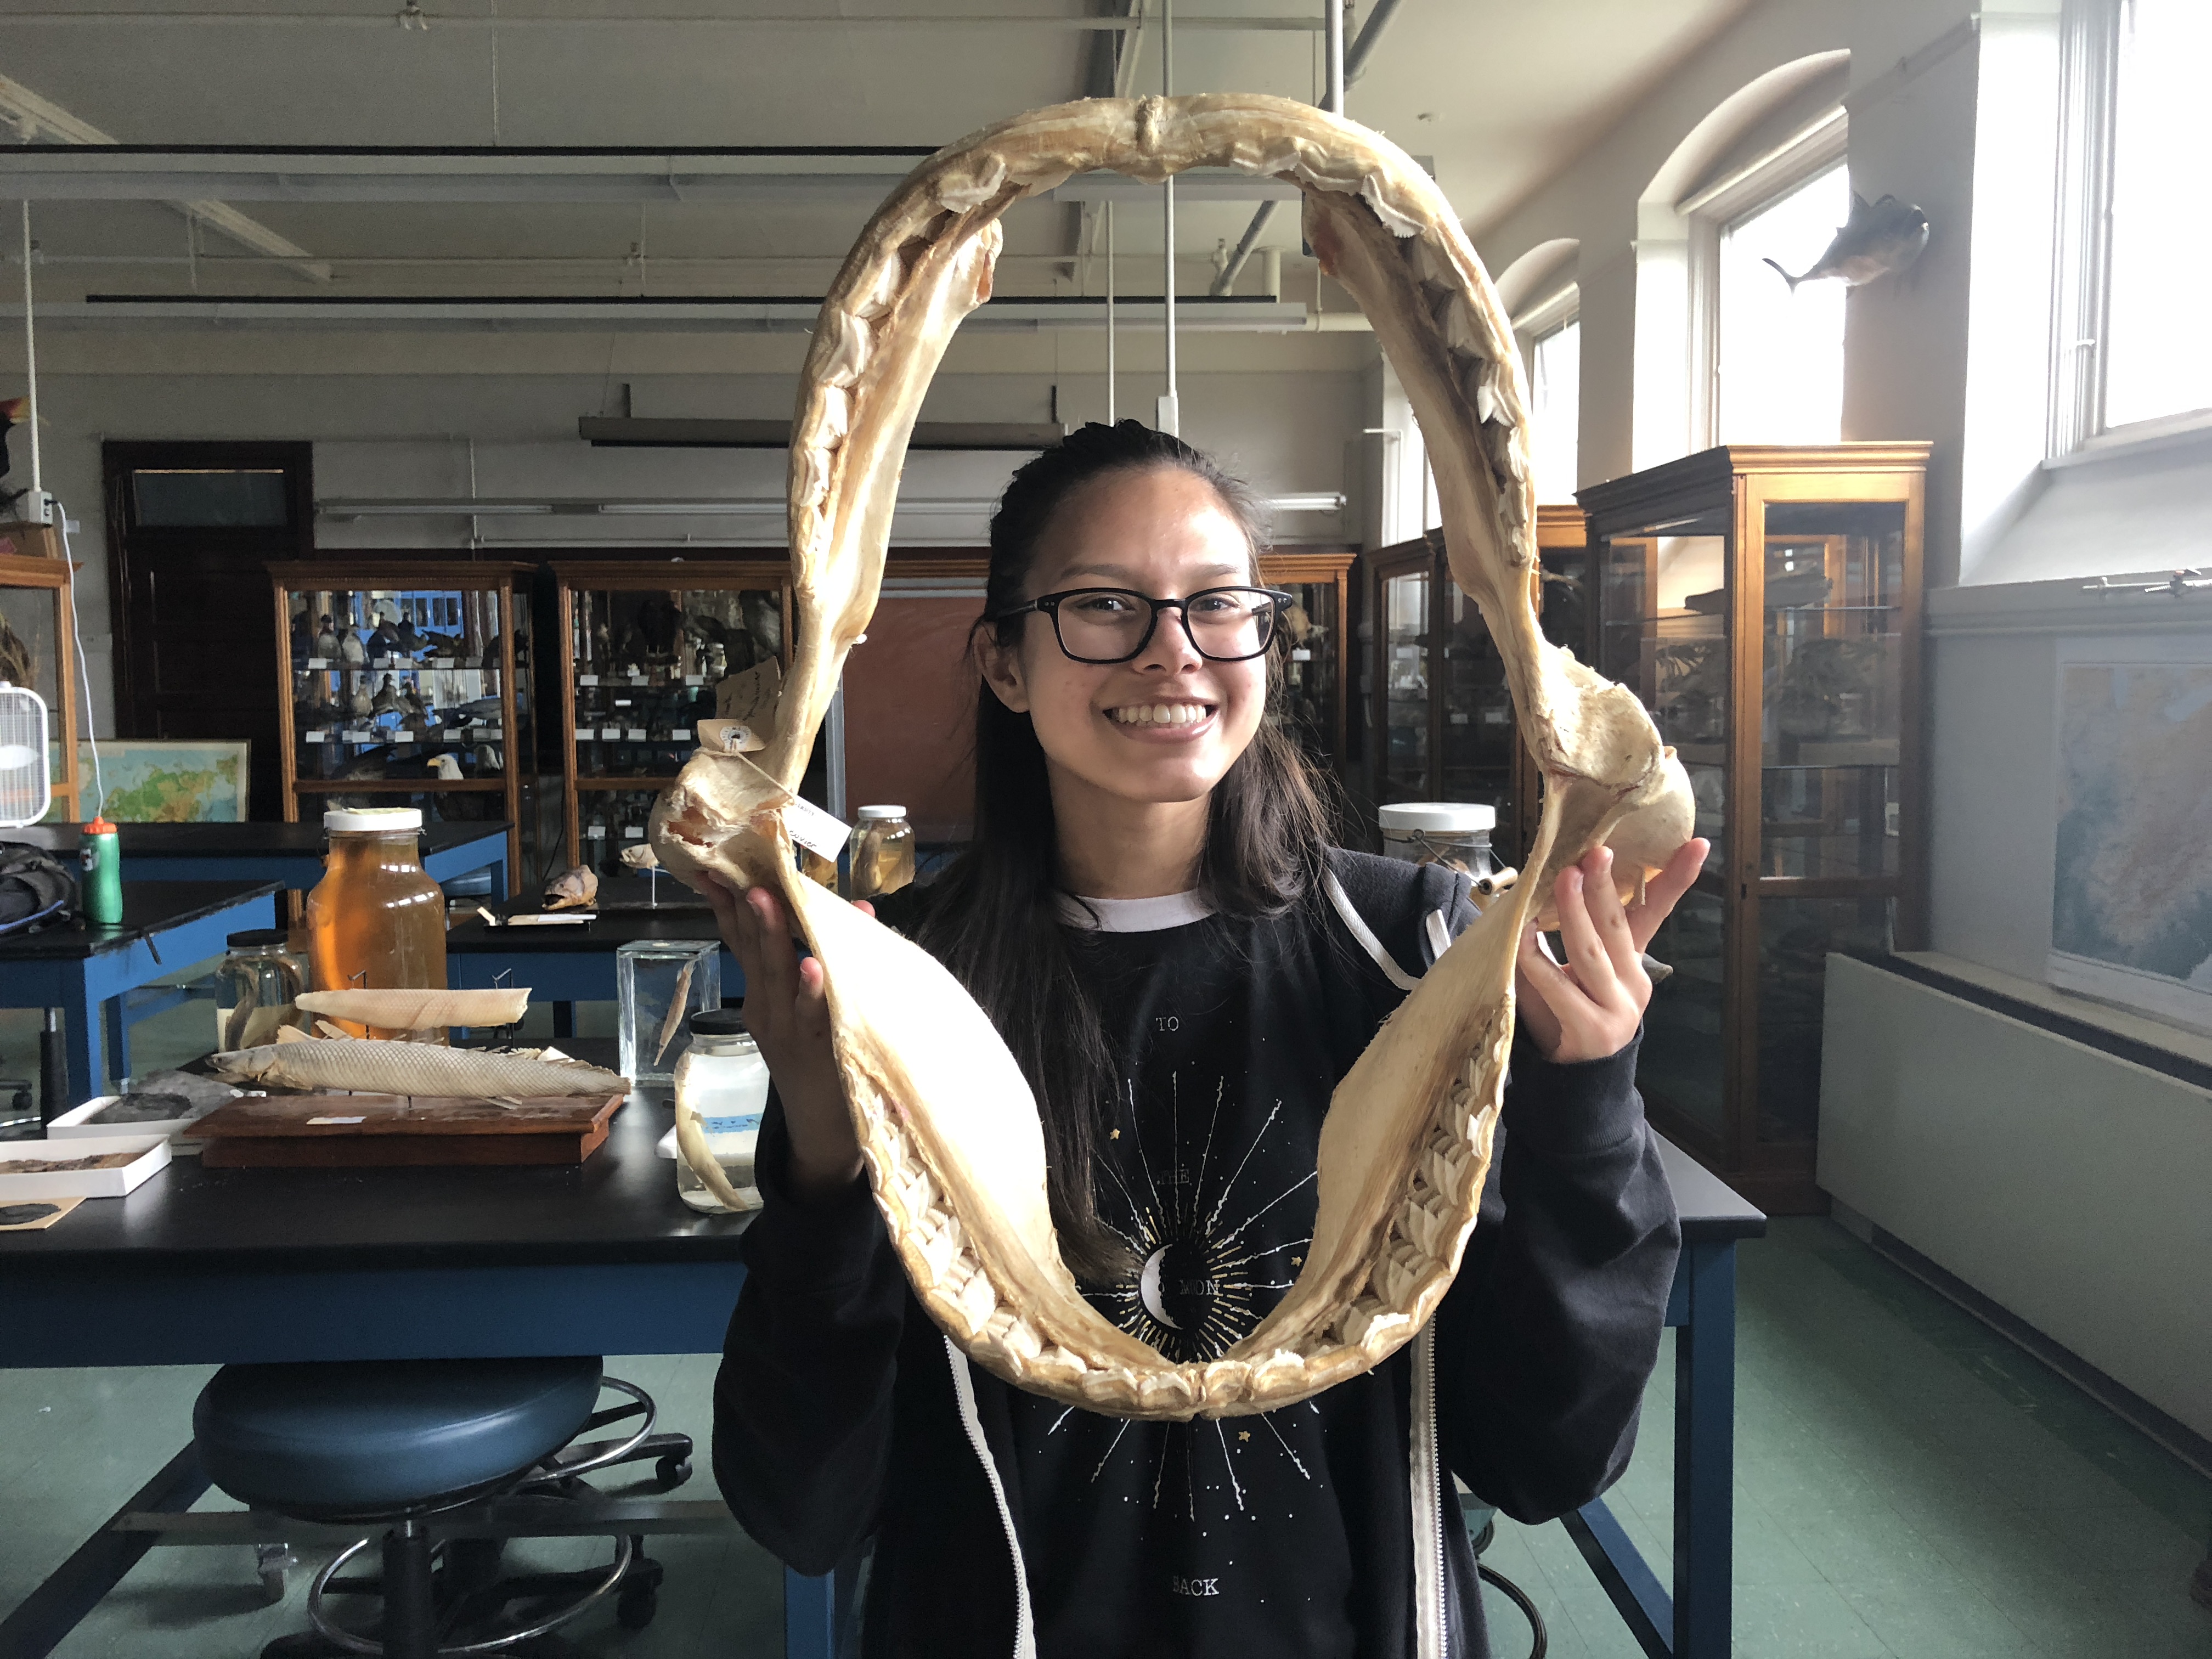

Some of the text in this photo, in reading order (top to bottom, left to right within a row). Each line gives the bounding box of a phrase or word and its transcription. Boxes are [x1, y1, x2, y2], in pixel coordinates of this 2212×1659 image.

[795, 803, 815, 816] ERSITY
[1155, 1015, 1180, 1032] TO
[1156, 1168, 1190, 1186] THE
[1172, 1575, 1220, 1596] BACK
